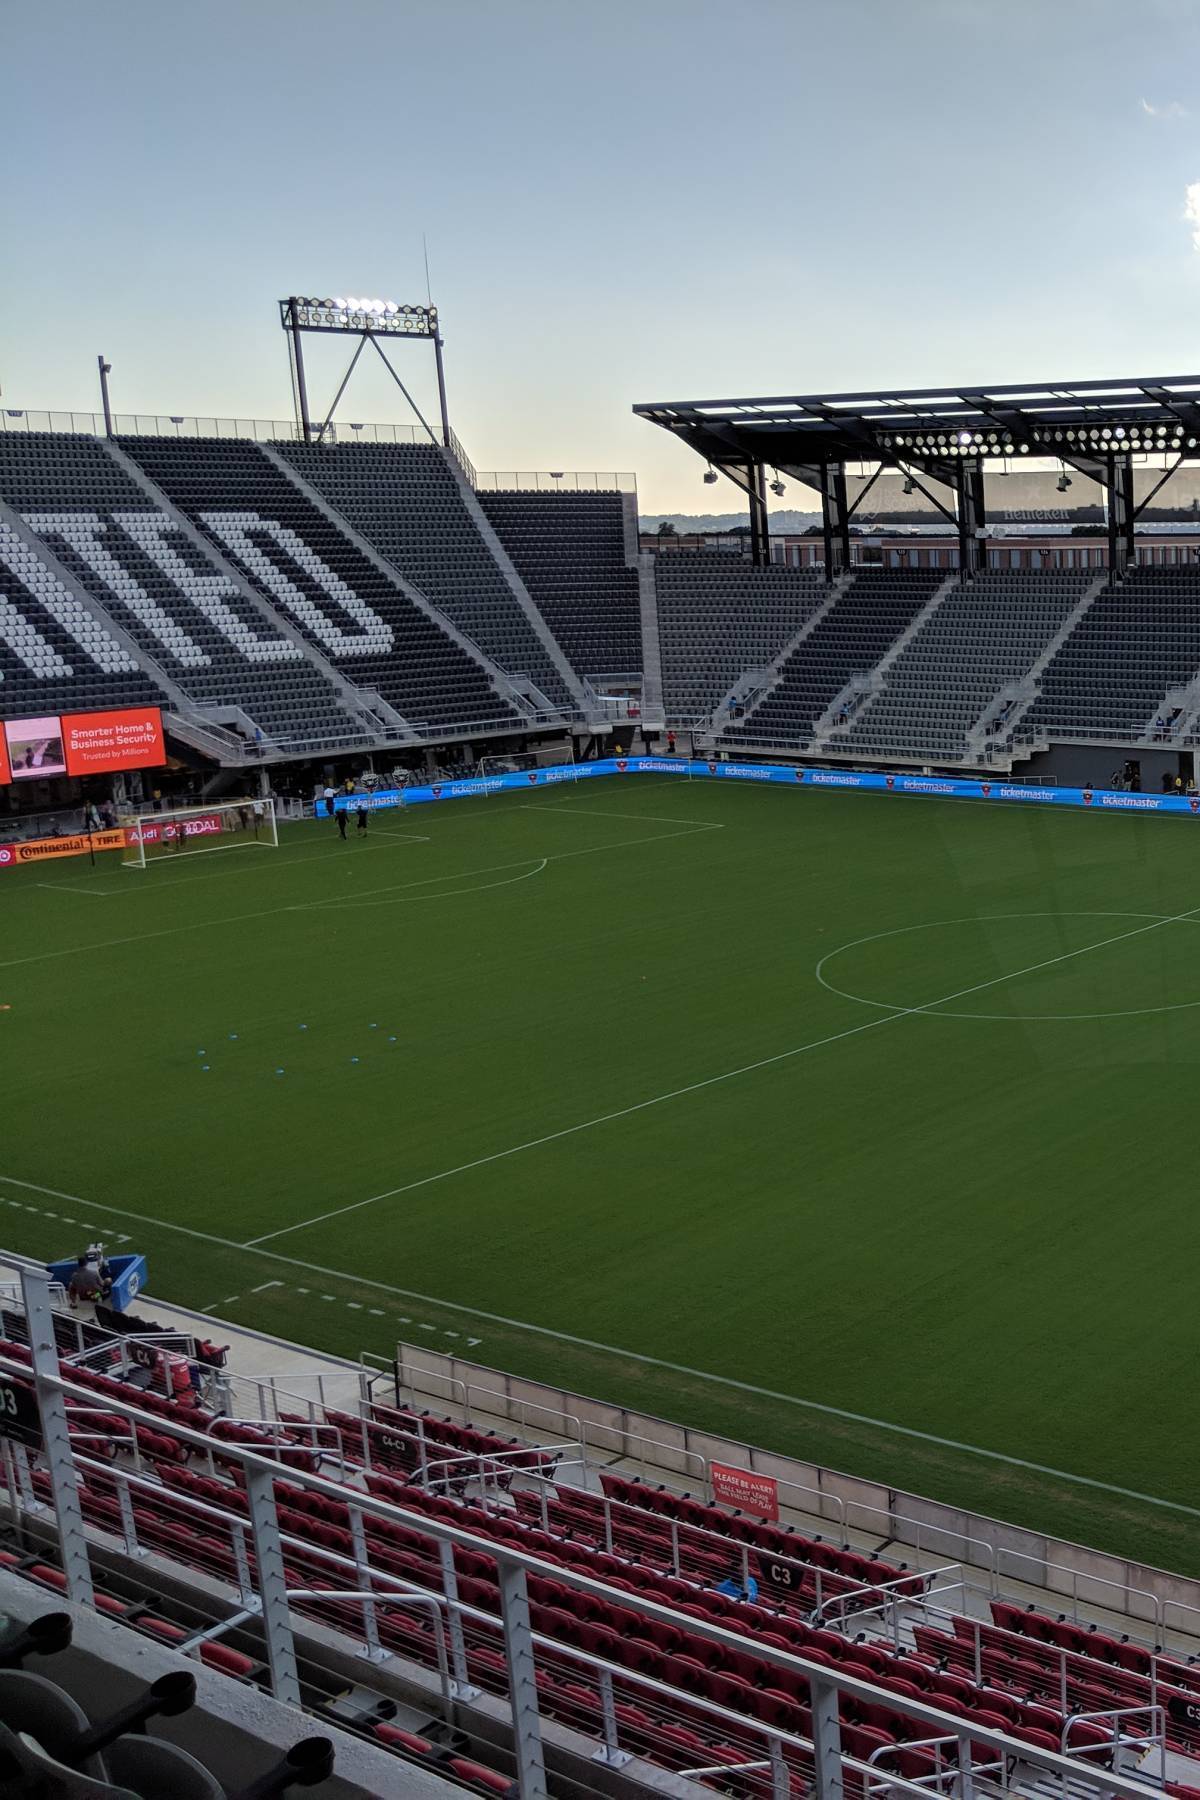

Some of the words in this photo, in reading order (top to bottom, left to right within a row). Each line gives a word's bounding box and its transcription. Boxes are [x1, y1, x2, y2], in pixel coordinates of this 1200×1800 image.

[71, 727, 113, 739] Smarter
[115, 724, 144, 735] Home
[146, 722, 153, 732] &
[71, 738, 115, 750] Business
[116, 733, 157, 745] Security
[82, 752, 111, 761] Trusted
[112, 750, 121, 759] by
[122, 747, 149, 757] Millions
[1000, 787, 1055, 801] ticketmaster
[1102, 794, 1160, 809] ticketmaster
[130, 828, 157, 841] Audi
[20, 838, 84, 860] Continental
[96, 835, 121, 846] TIRE
[382, 1435, 405, 1451] C4-C3
[713, 1472, 739, 1486] PLEASE
[740, 1479, 749, 1489] BE
[719, 1483, 735, 1493] BALL
[771, 1564, 792, 1585] C3
